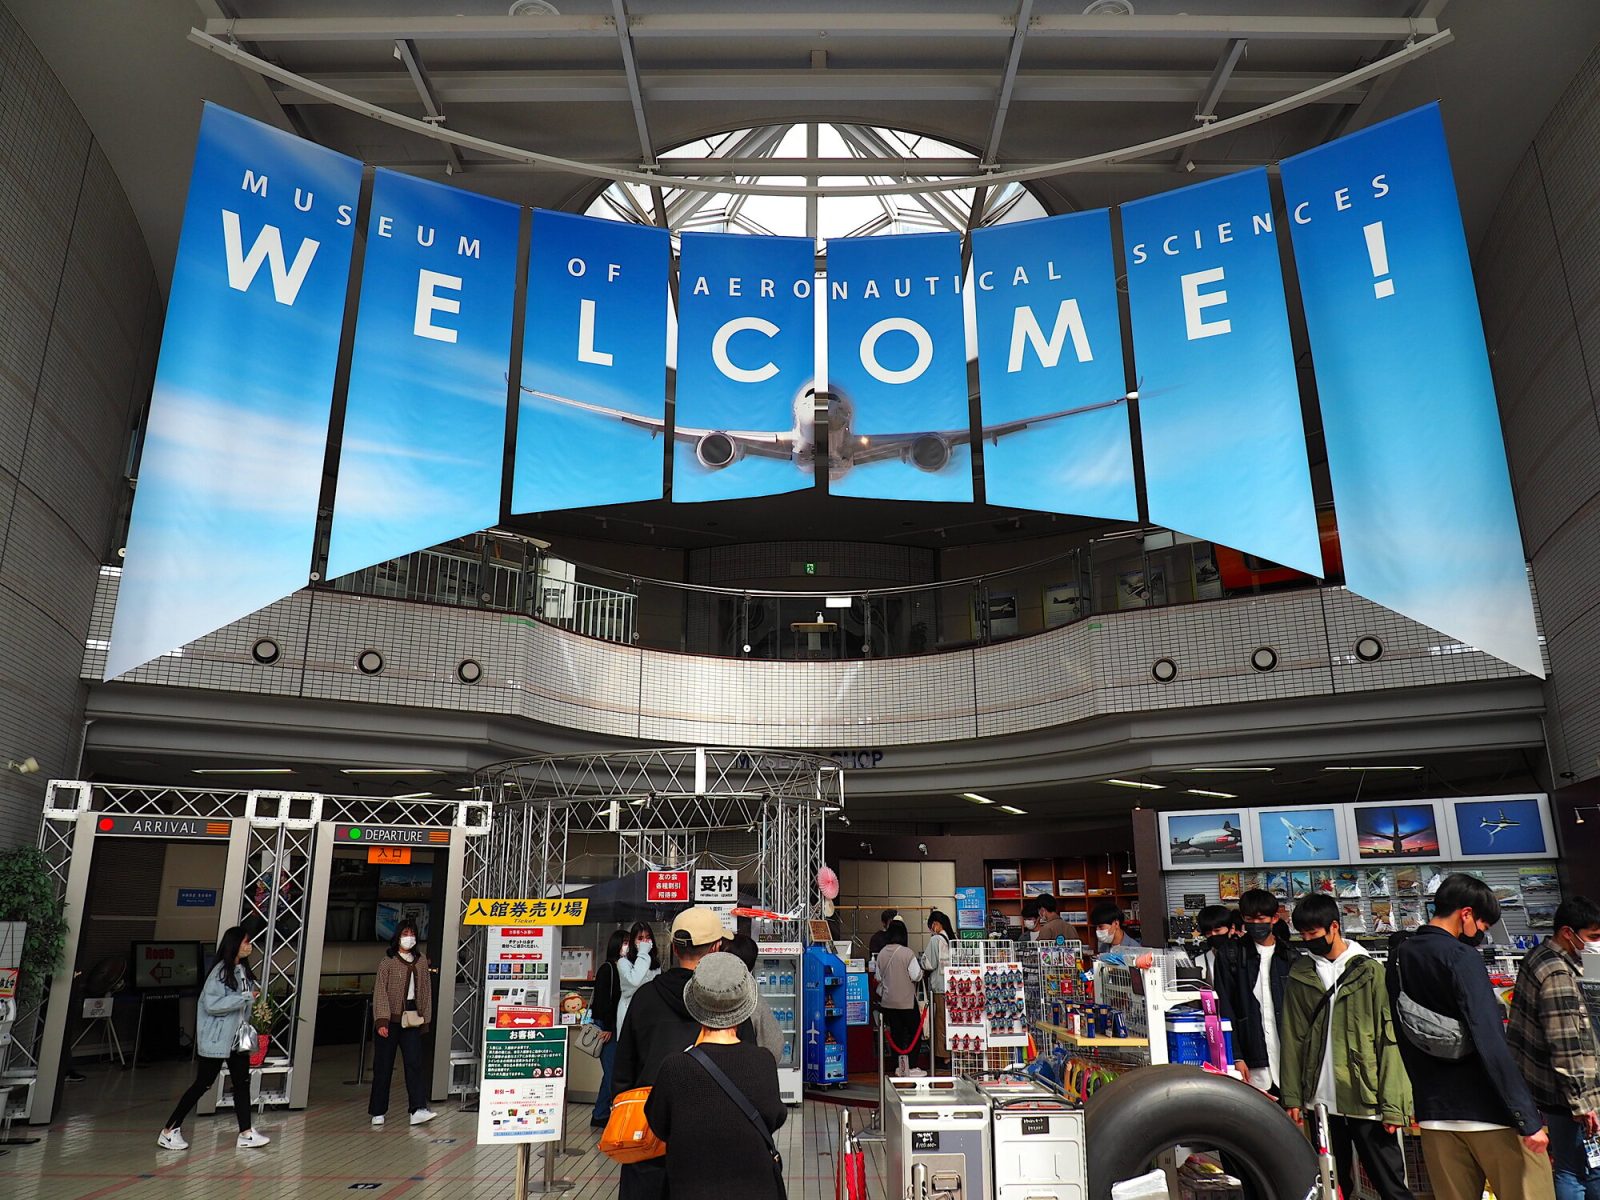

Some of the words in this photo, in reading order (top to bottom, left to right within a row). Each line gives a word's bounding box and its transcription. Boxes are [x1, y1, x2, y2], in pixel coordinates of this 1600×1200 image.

[241, 169, 482, 260] MUSEUM
[567, 257, 622, 283] OF
[693, 260, 1062, 299] AERONAUTICAL
[1132, 173, 1391, 265] SCIENCES
[133, 820, 197, 834] ARRIVAL
[365, 829, 423, 842] DEPARTURE
[377, 848, 402, 858] 入口
[700, 876, 733, 892] 受付
[470, 901, 583, 918] 入館券売り場
[509, 1030, 545, 1040] お客様へ
